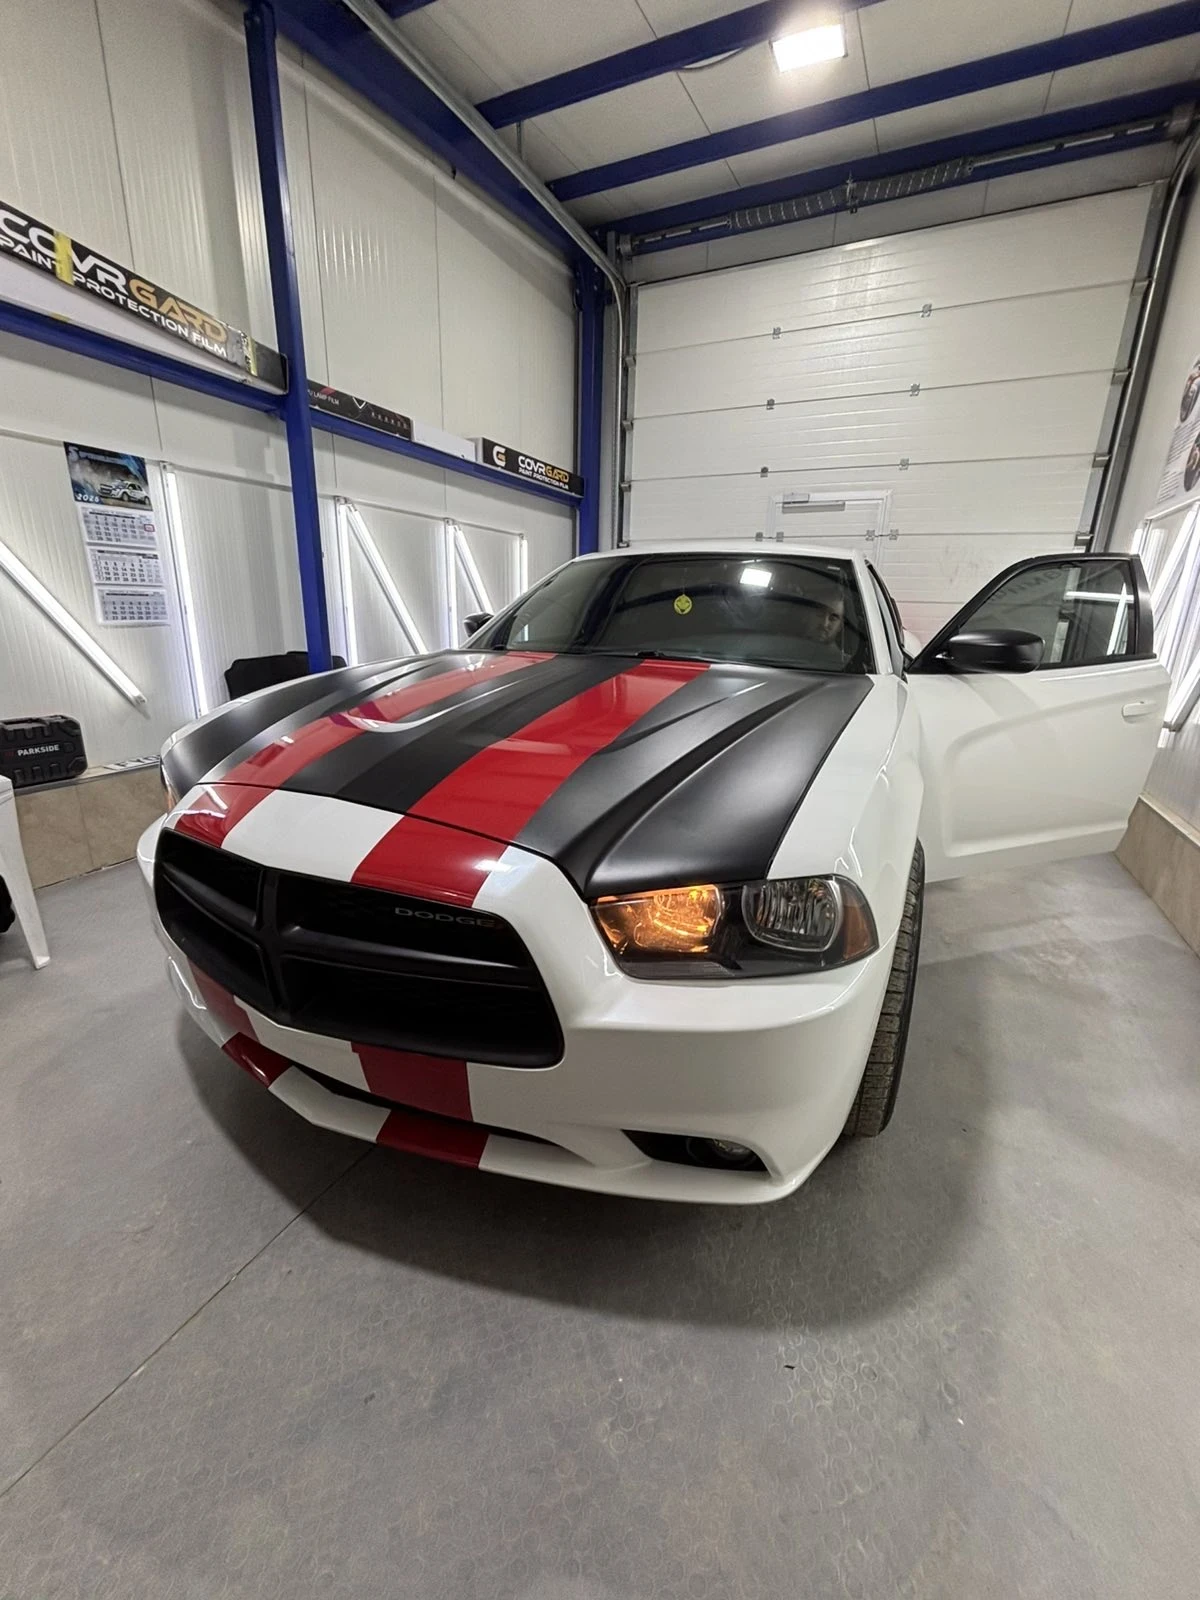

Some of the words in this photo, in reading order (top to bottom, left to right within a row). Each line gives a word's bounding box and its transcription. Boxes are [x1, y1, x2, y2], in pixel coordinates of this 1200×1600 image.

[73, 271, 188, 338] PROTECTION
[192, 331, 227, 358] FILM
[518, 455, 570, 483] COVRGARD
[17, 744, 60, 756] PARKSIDE
[394, 907, 496, 928] DODGE
